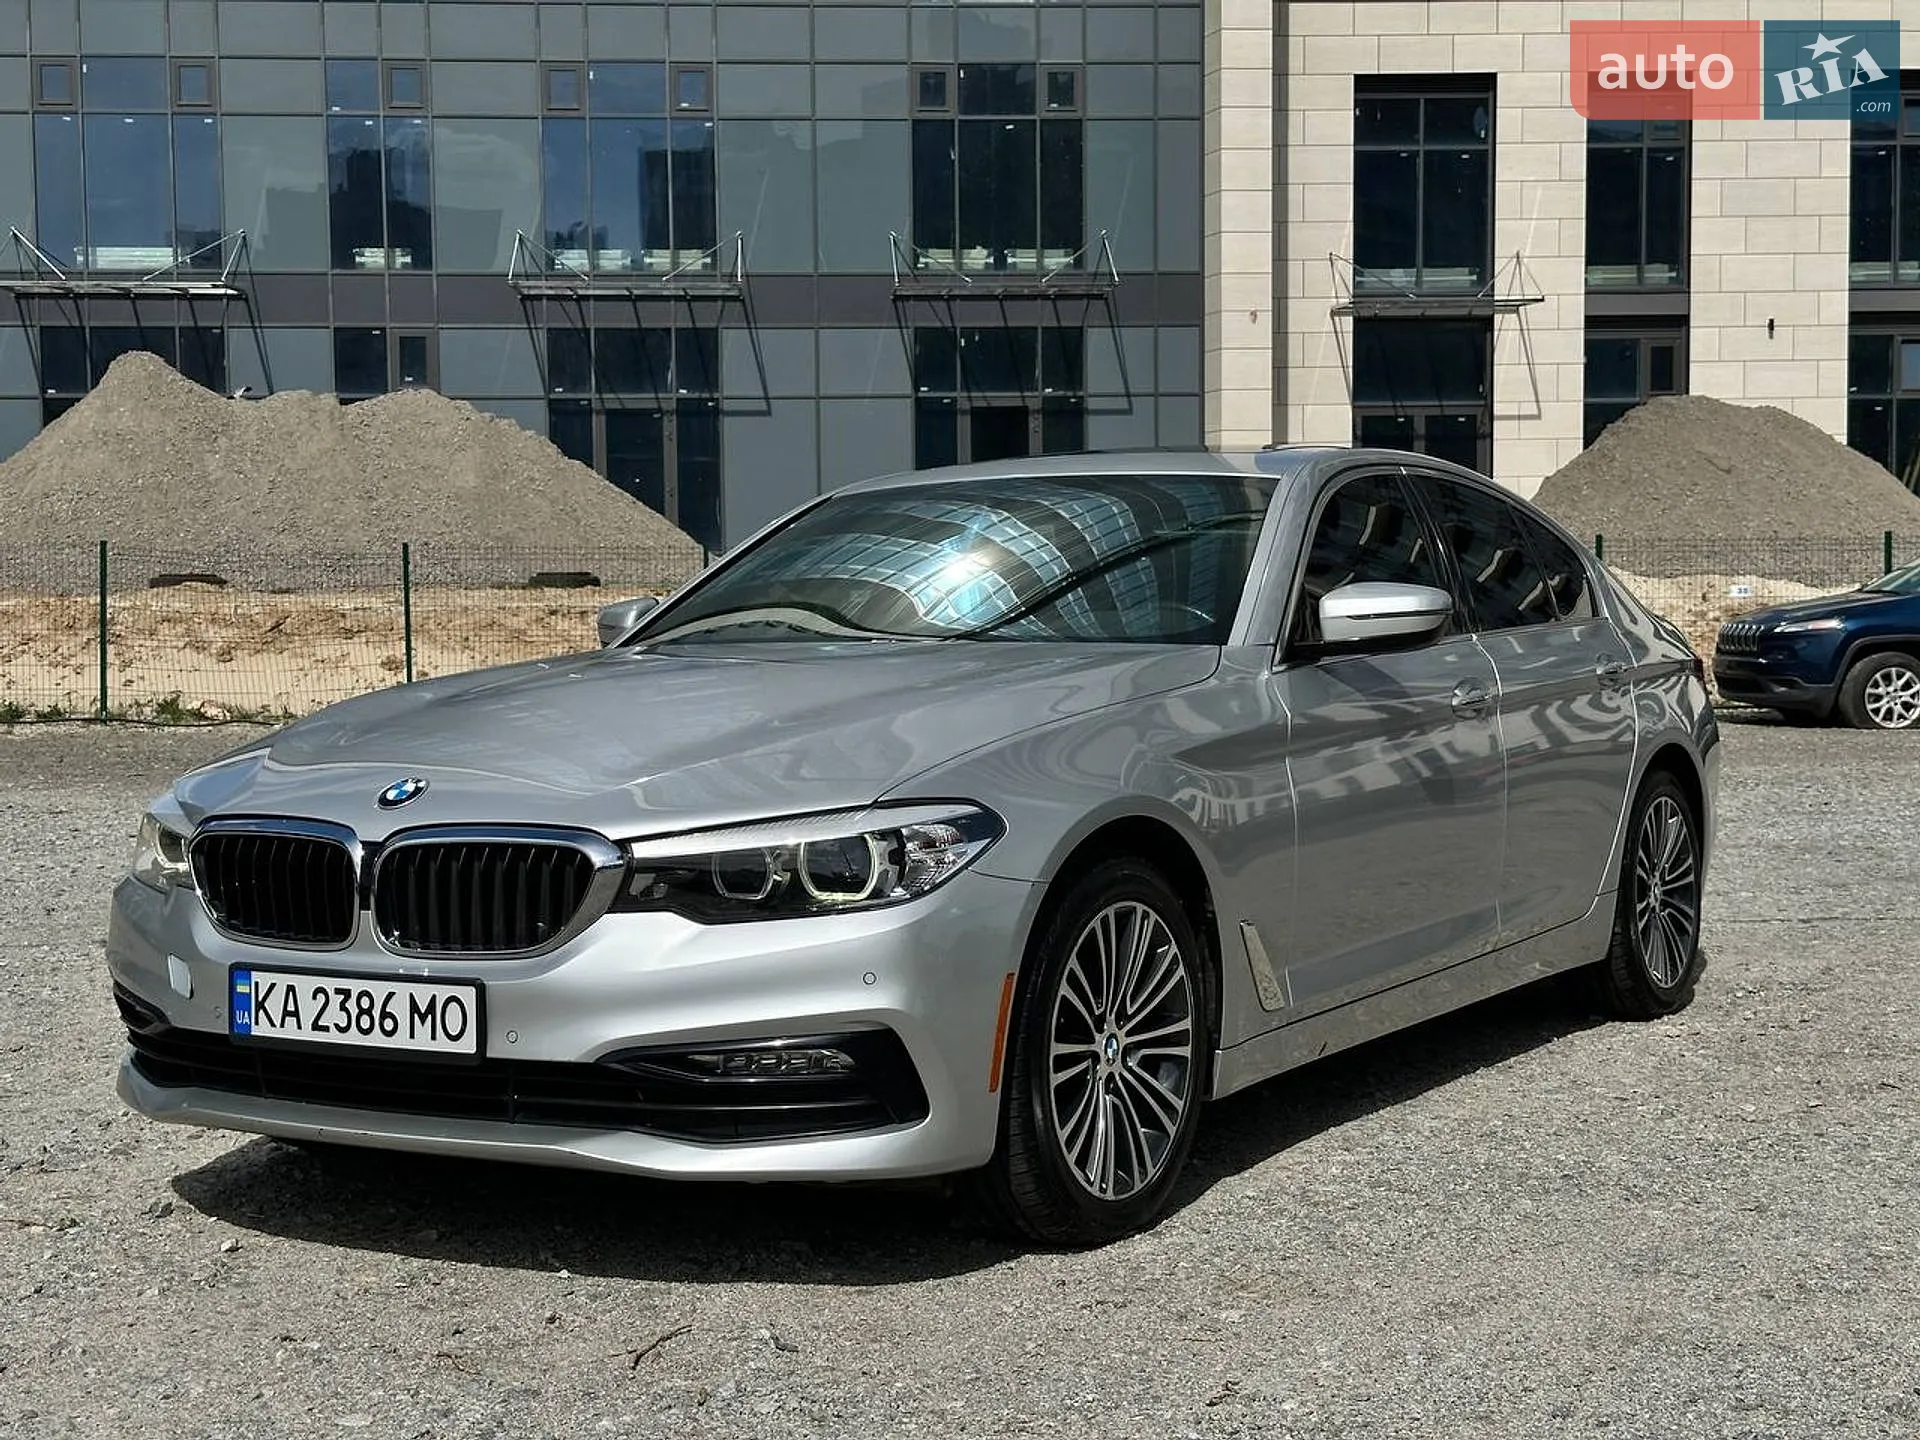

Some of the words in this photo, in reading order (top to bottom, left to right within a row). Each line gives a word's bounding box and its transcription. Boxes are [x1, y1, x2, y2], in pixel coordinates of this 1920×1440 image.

[235, 1010, 251, 1025] UA
[253, 980, 303, 1030] KA
[310, 985, 400, 1038] 2386
[408, 991, 468, 1043] MO
